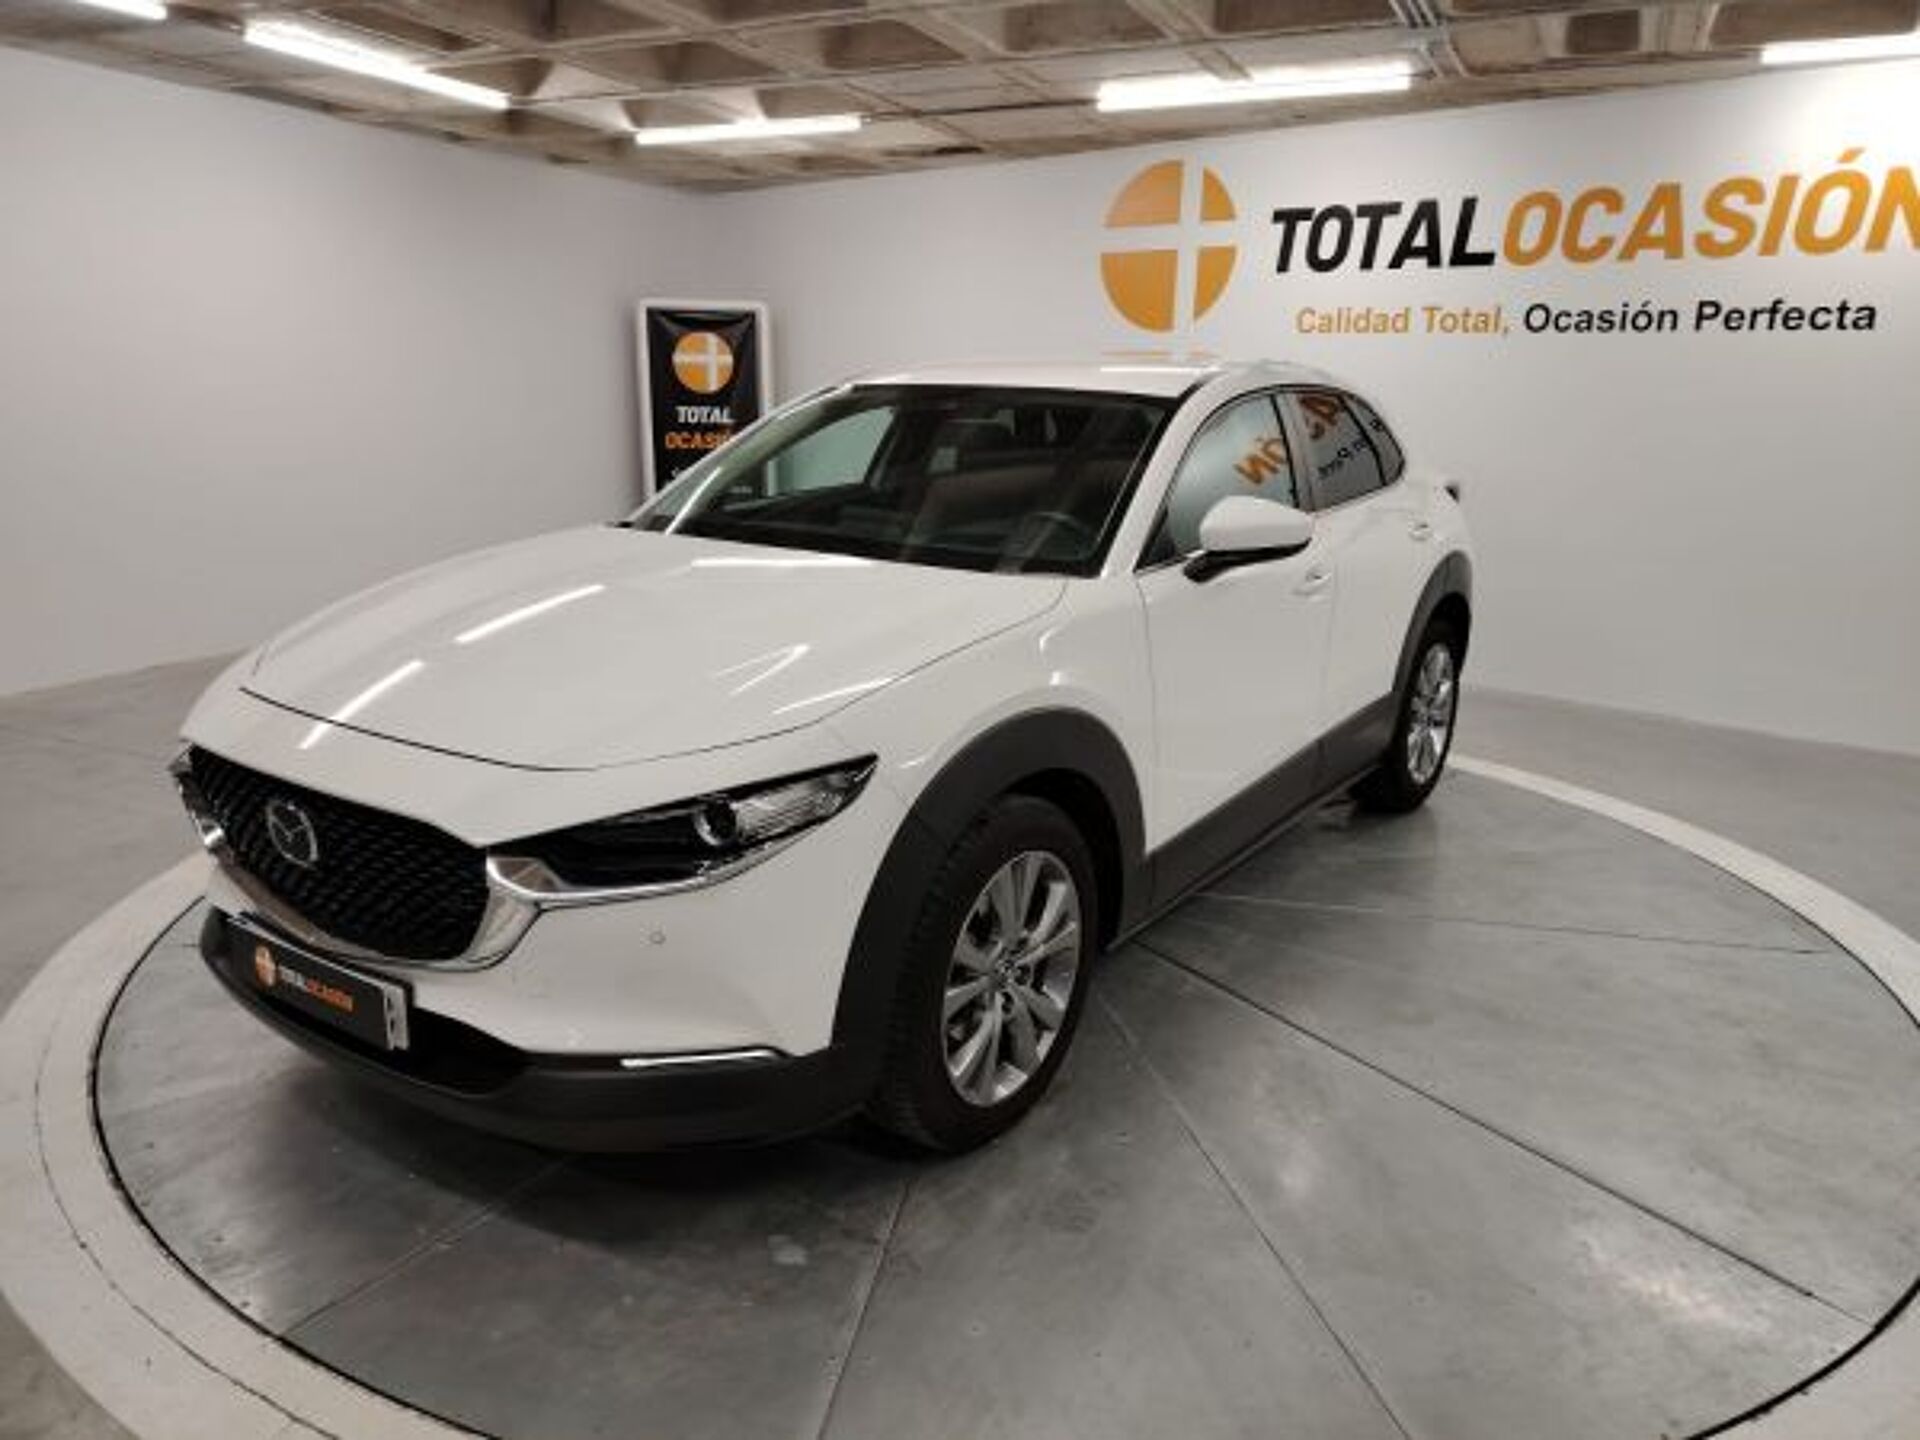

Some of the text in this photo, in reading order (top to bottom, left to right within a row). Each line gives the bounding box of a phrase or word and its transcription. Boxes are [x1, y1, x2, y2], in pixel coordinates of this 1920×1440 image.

[1296, 298, 1877, 338] Calidad Total, Ocasión Perfecta
[675, 405, 734, 424] TOTAL
